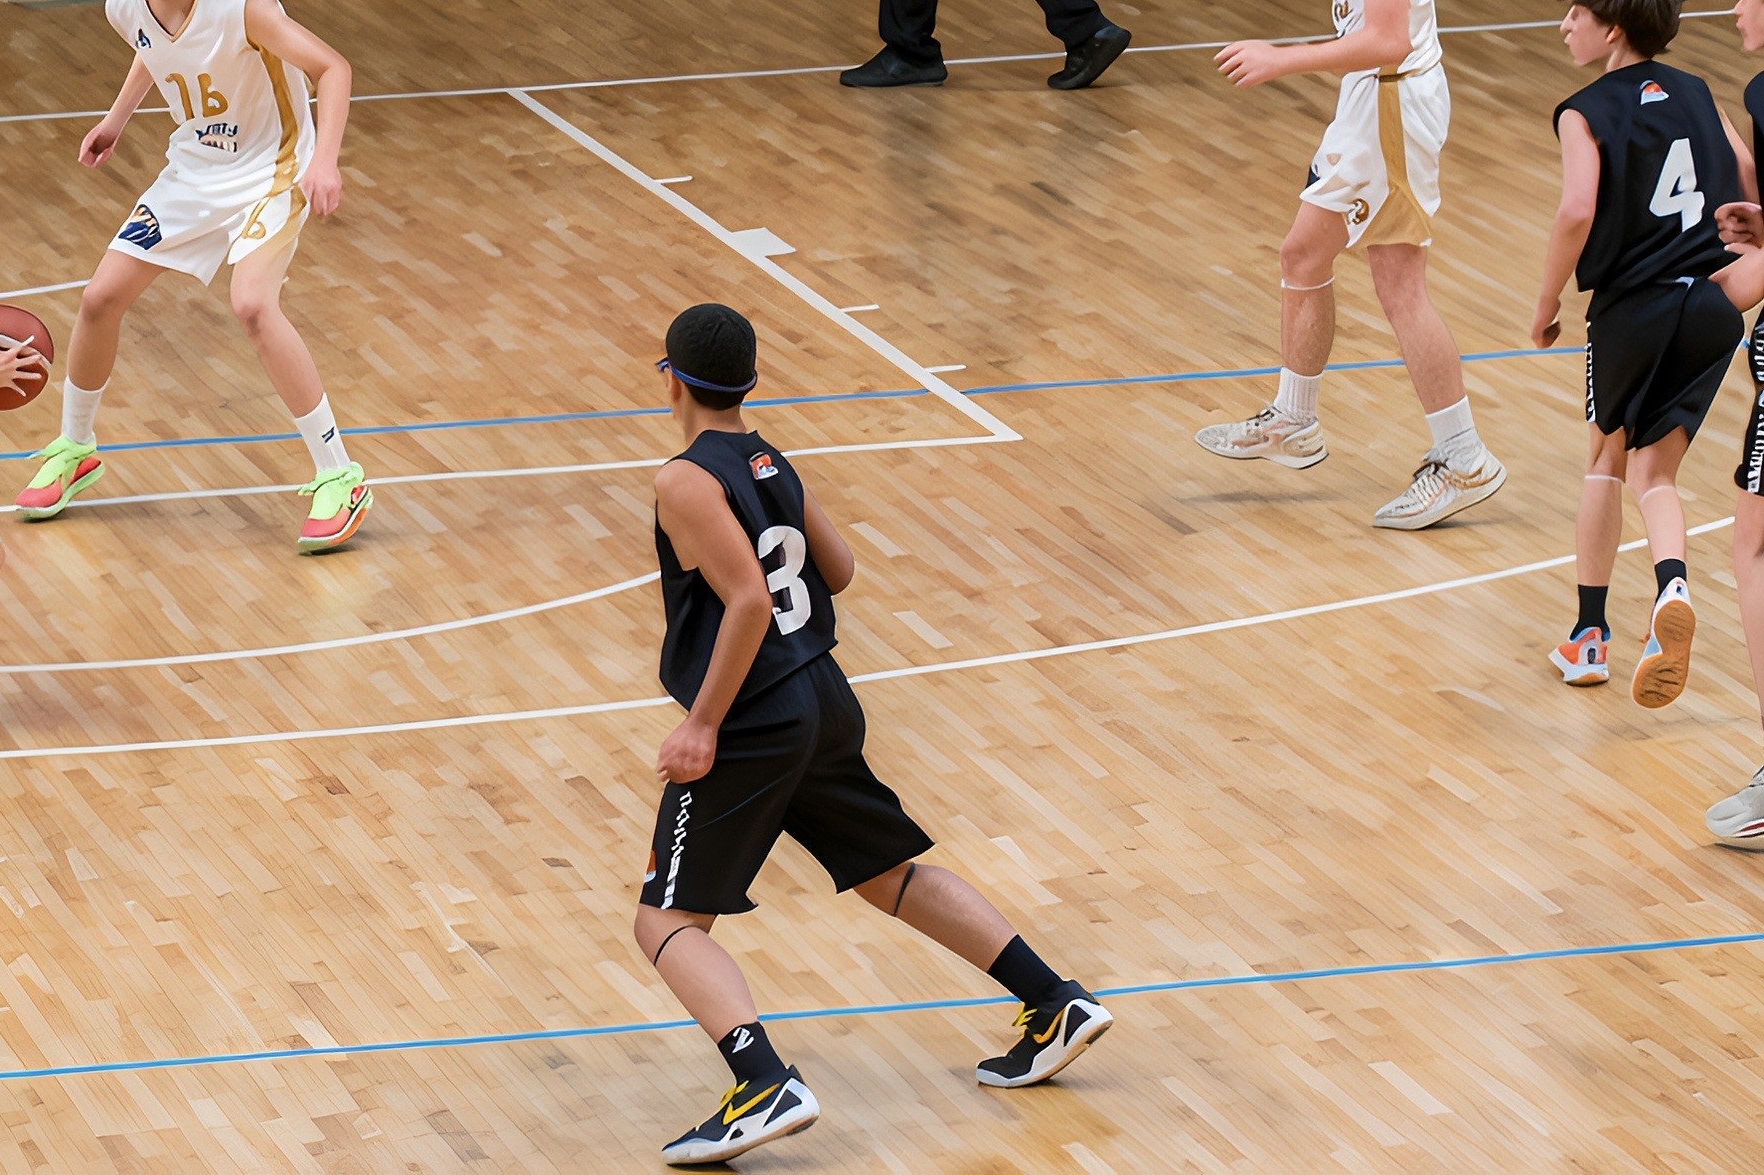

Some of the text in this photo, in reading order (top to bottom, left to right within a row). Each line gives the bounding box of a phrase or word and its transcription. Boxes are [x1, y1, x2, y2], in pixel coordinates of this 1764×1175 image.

[165, 73, 229, 121] 16
[1649, 137, 1705, 233] 4
[757, 525, 811, 636] 3
